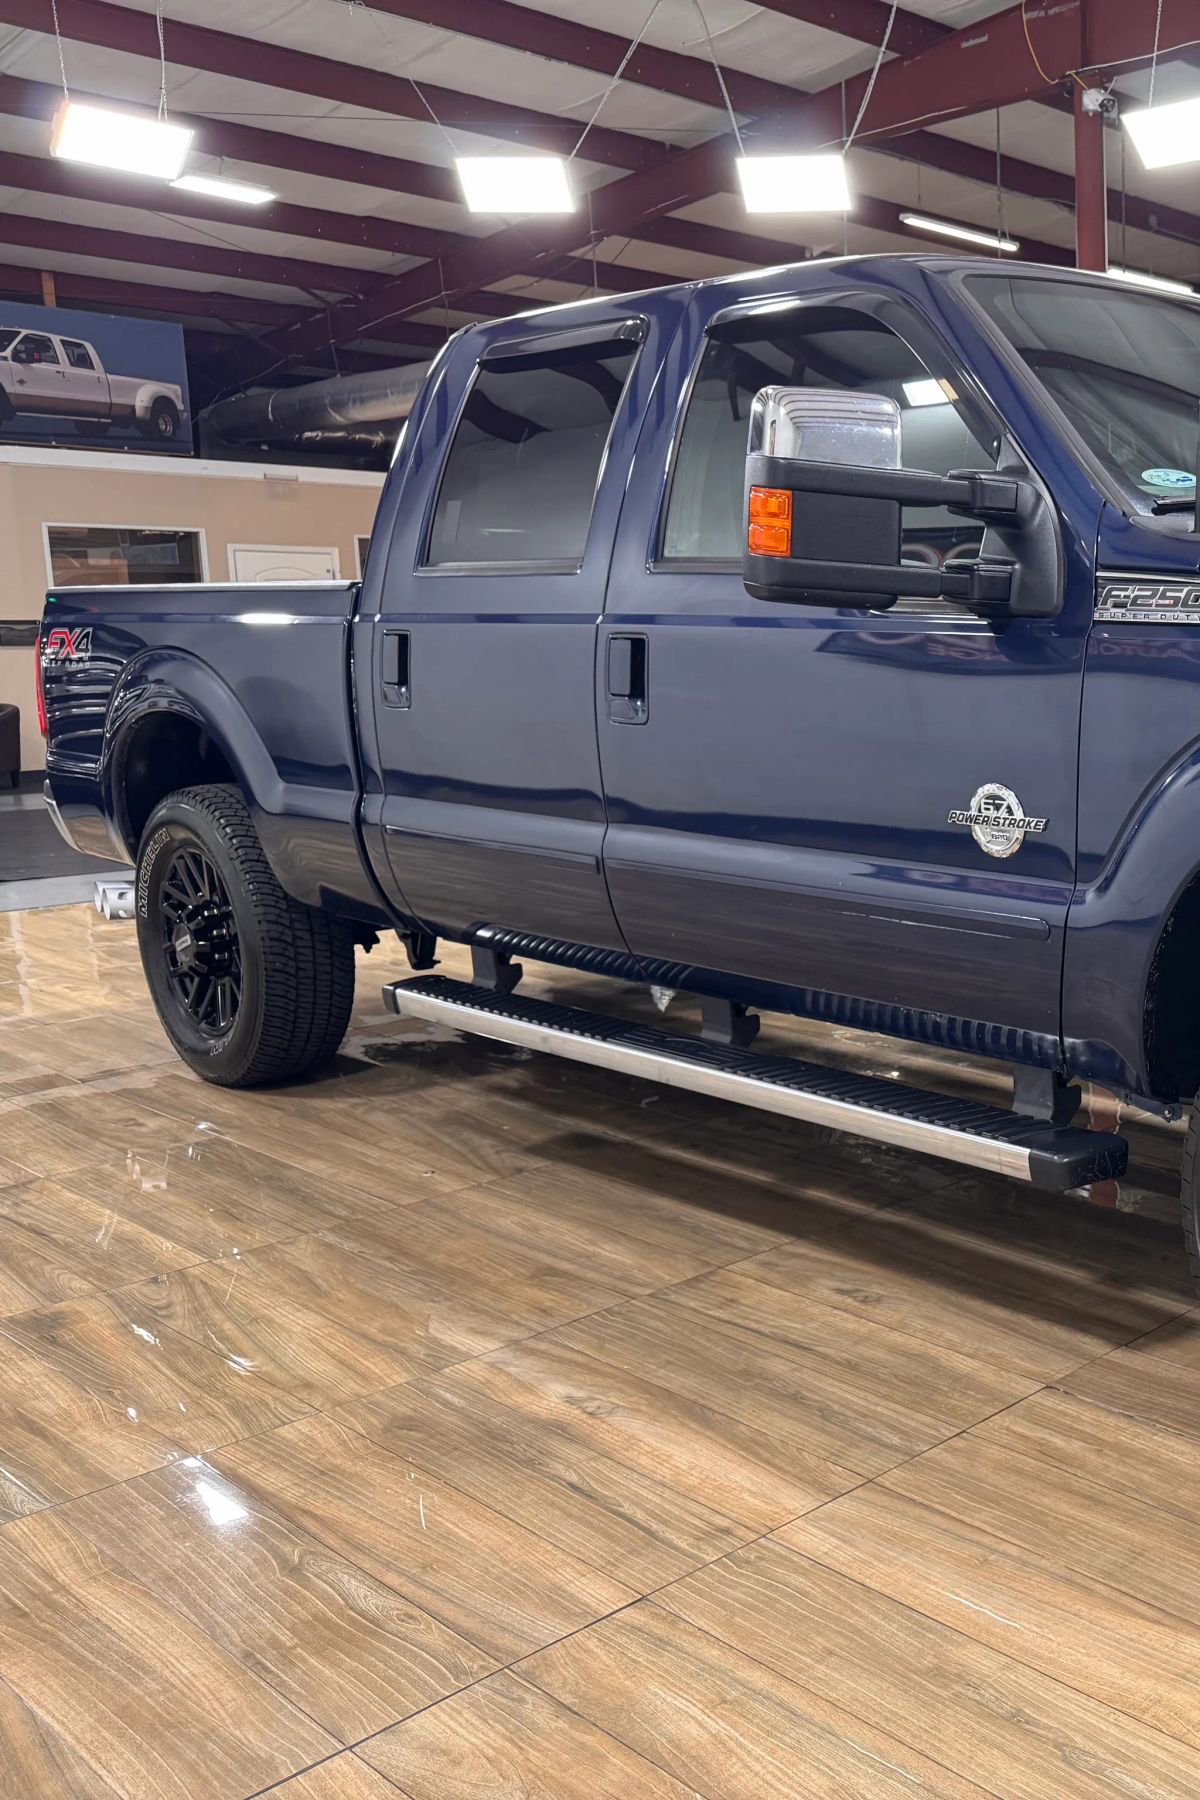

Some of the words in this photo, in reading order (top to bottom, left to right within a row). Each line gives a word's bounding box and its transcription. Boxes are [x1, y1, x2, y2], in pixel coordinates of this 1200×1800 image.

[1098, 612, 1150, 620] SUPER
[48, 627, 93, 659] FX4
[949, 811, 990, 826] POWER
[992, 815, 1044, 831] STROKE
[138, 827, 170, 918] MICHELIN
